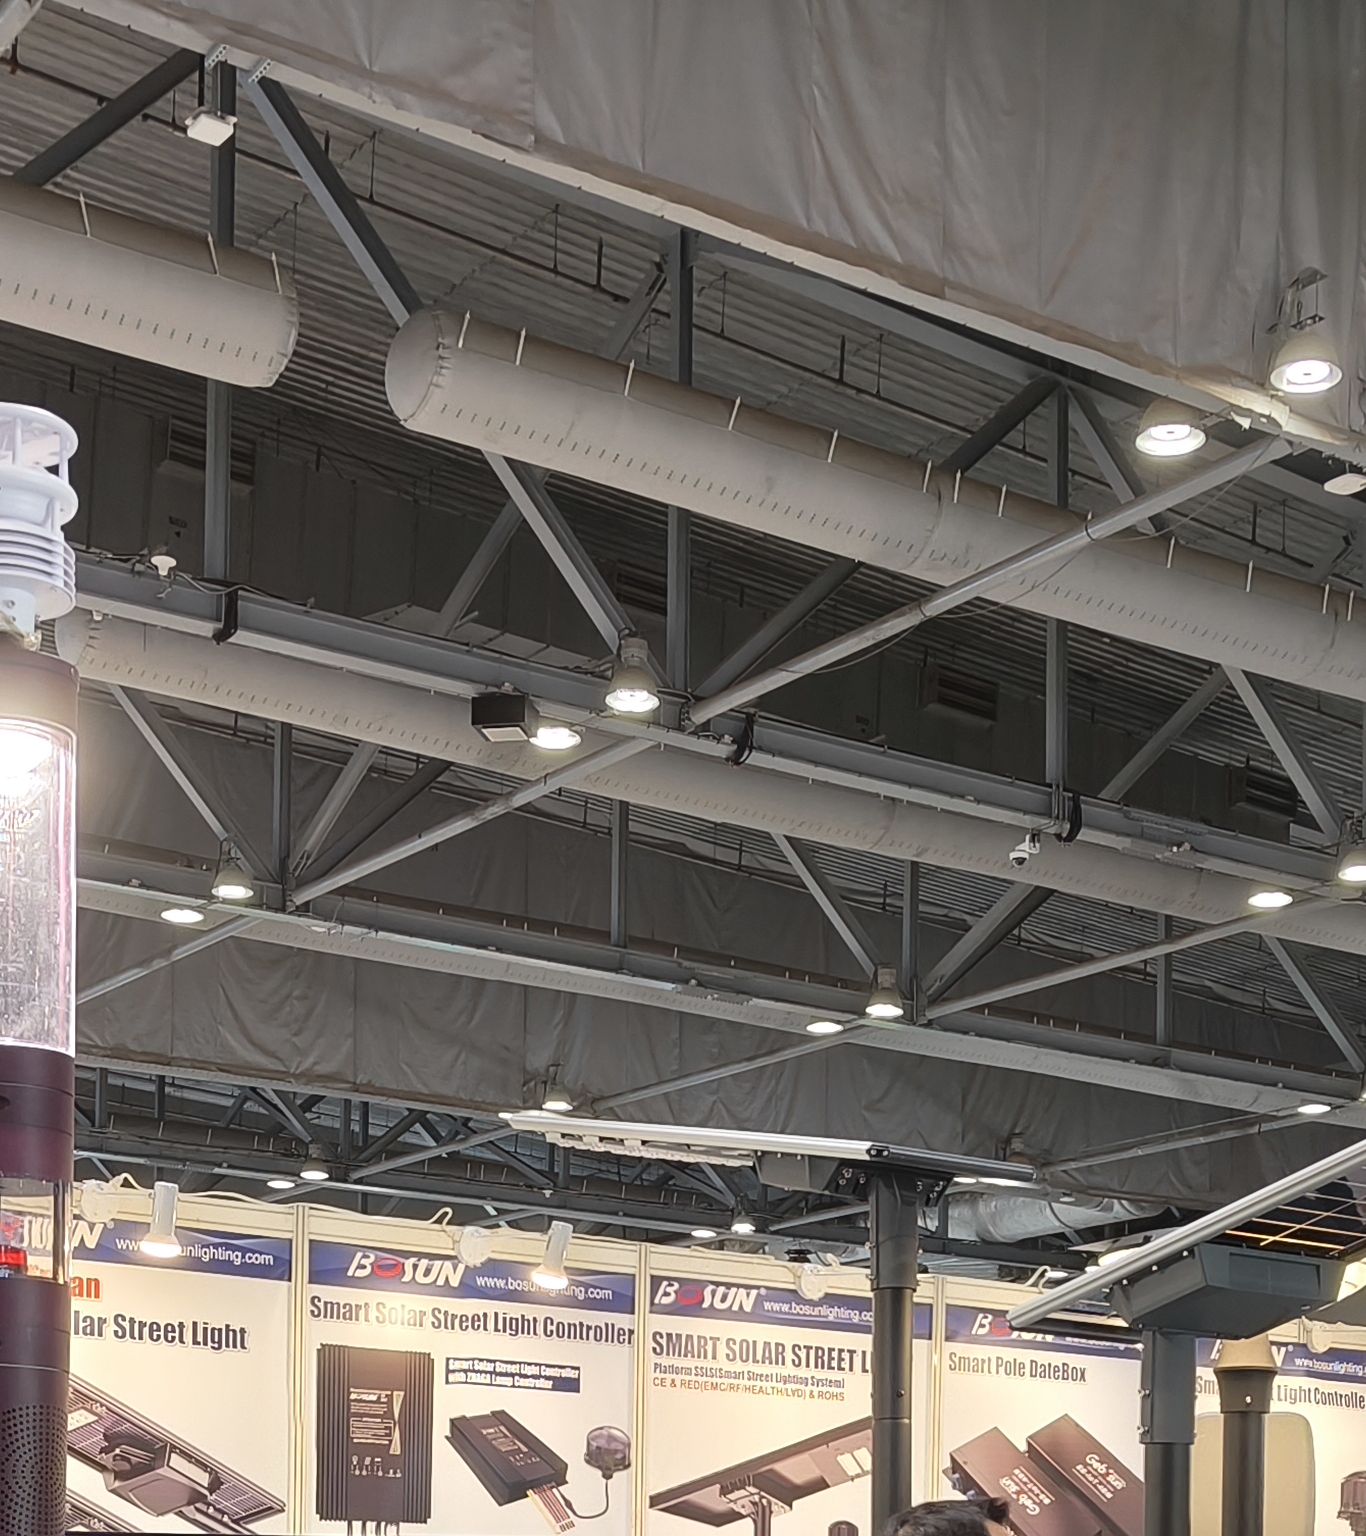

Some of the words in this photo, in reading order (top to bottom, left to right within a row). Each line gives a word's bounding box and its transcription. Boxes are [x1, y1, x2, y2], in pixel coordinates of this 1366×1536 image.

[115, 1237, 274, 1265] wwunlighting.com
[347, 1251, 465, 1287] BOSUN
[654, 1280, 758, 1312] BOSUN
[310, 1295, 370, 1323] Smart
[375, 1301, 426, 1328] Solar
[431, 1307, 489, 1332] Street
[493, 1311, 539, 1337] Light
[542, 1316, 634, 1345] Controller
[763, 1300, 873, 1323] www.bosunlighting.co
[73, 1310, 107, 1338] lar
[113, 1313, 186, 1345] Street
[191, 1320, 248, 1351] Light
[652, 1331, 720, 1361] SMART
[725, 1337, 786, 1366] SOLAR
[791, 1344, 857, 1372] STREET
[653, 1362, 693, 1377] Platform
[747, 1370, 773, 1382] Street
[776, 1373, 809, 1387] Lighting
[948, 1352, 992, 1374] Smart
[996, 1356, 1025, 1378] Pole
[1030, 1360, 1086, 1382] DateBox
[653, 1377, 667, 1387] CE
[669, 1378, 677, 1388] &
[809, 1390, 815, 1399] &
[817, 1391, 845, 1401] ROHS
[1277, 1384, 1312, 1404] Light
